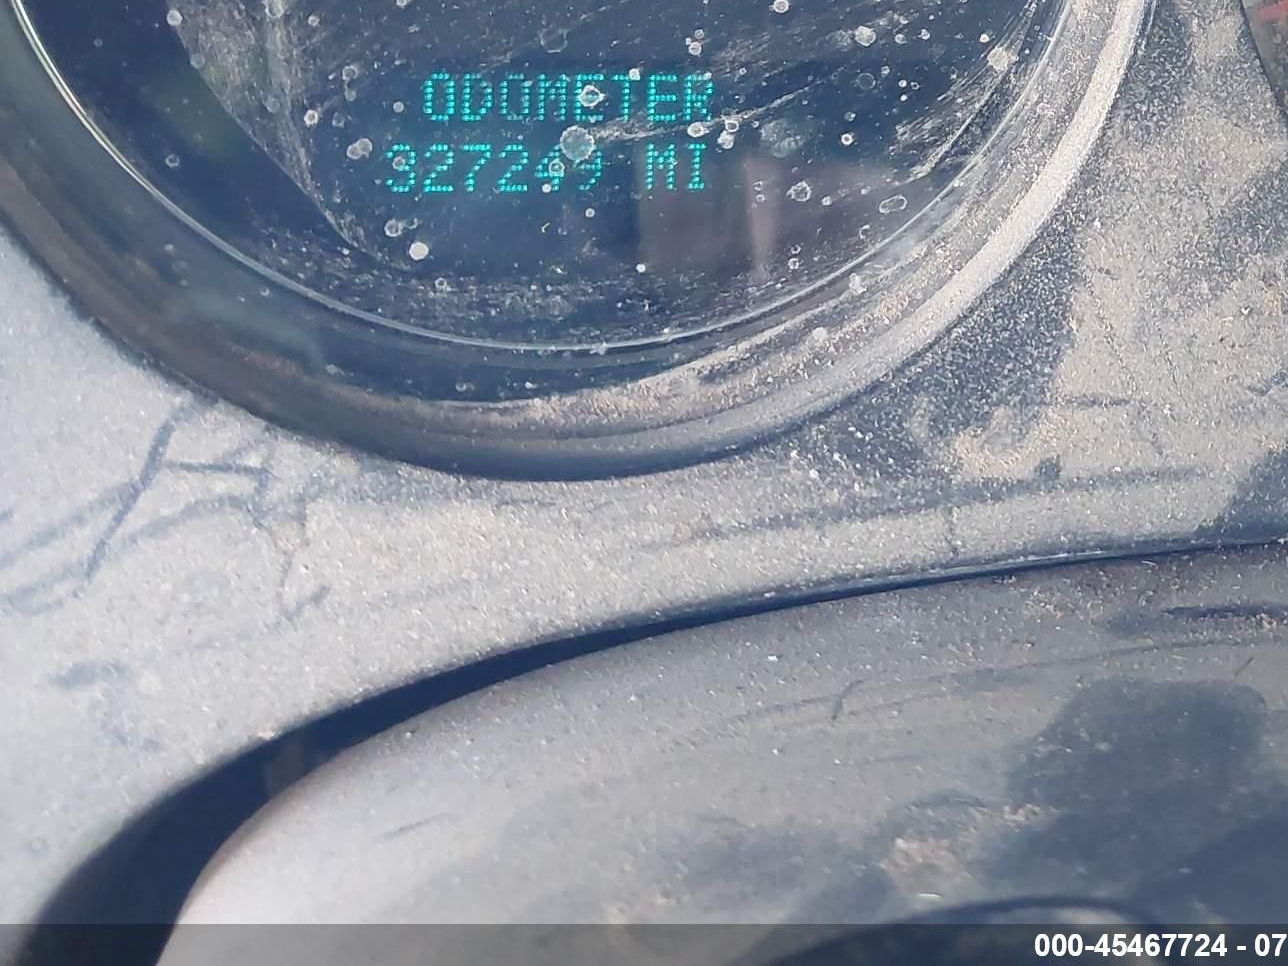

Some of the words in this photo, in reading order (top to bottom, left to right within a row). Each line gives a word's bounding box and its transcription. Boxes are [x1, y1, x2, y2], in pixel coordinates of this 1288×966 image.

[423, 71, 714, 122] ODOMETER
[384, 143, 603, 193] 327249
[645, 143, 707, 190] MI
